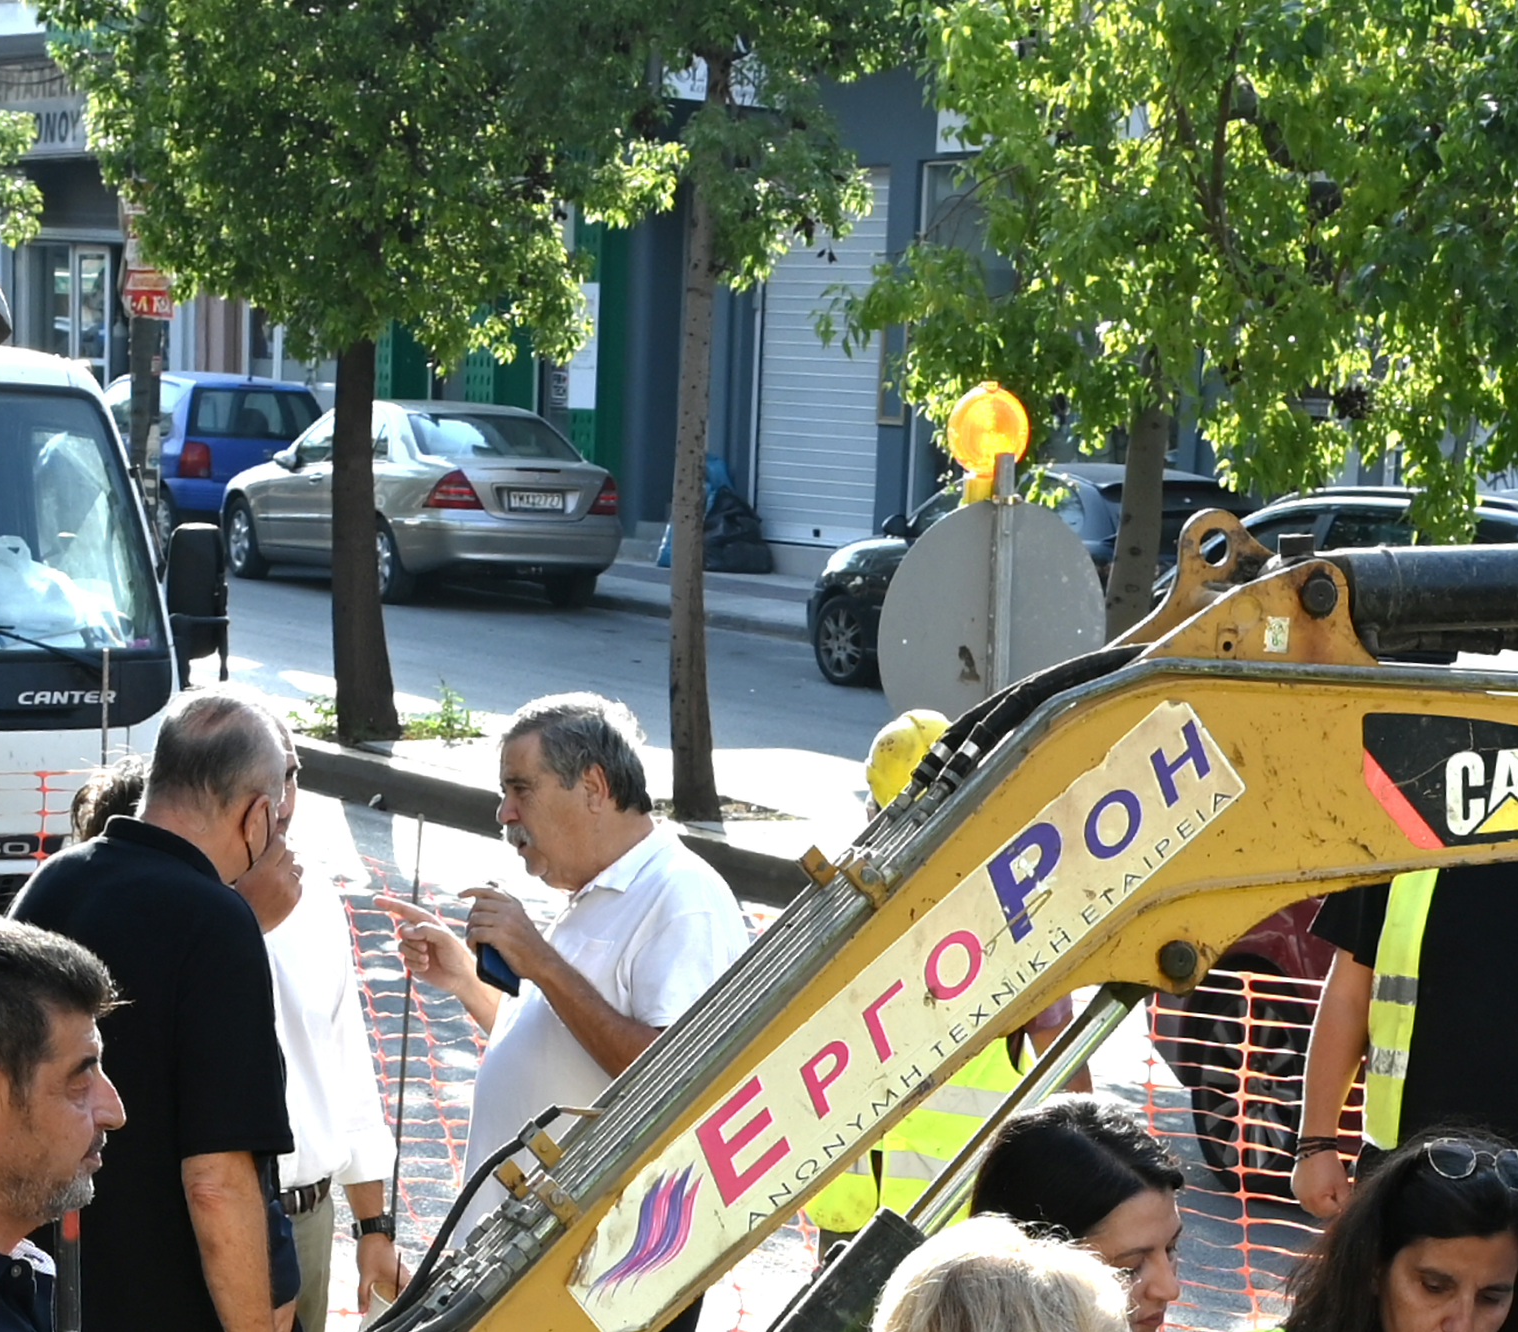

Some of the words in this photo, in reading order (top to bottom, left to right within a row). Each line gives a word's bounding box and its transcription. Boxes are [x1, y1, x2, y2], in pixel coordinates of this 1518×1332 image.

[18, 690, 117, 705] CANTER
[747, 1065, 922, 1232] ΑΝΩΝΥΜΗ
[929, 930, 1071, 1059] ΤΕΧΝΙΚΗ
[1081, 792, 1233, 925] ΕΤΑΙΡΕΙΑ
